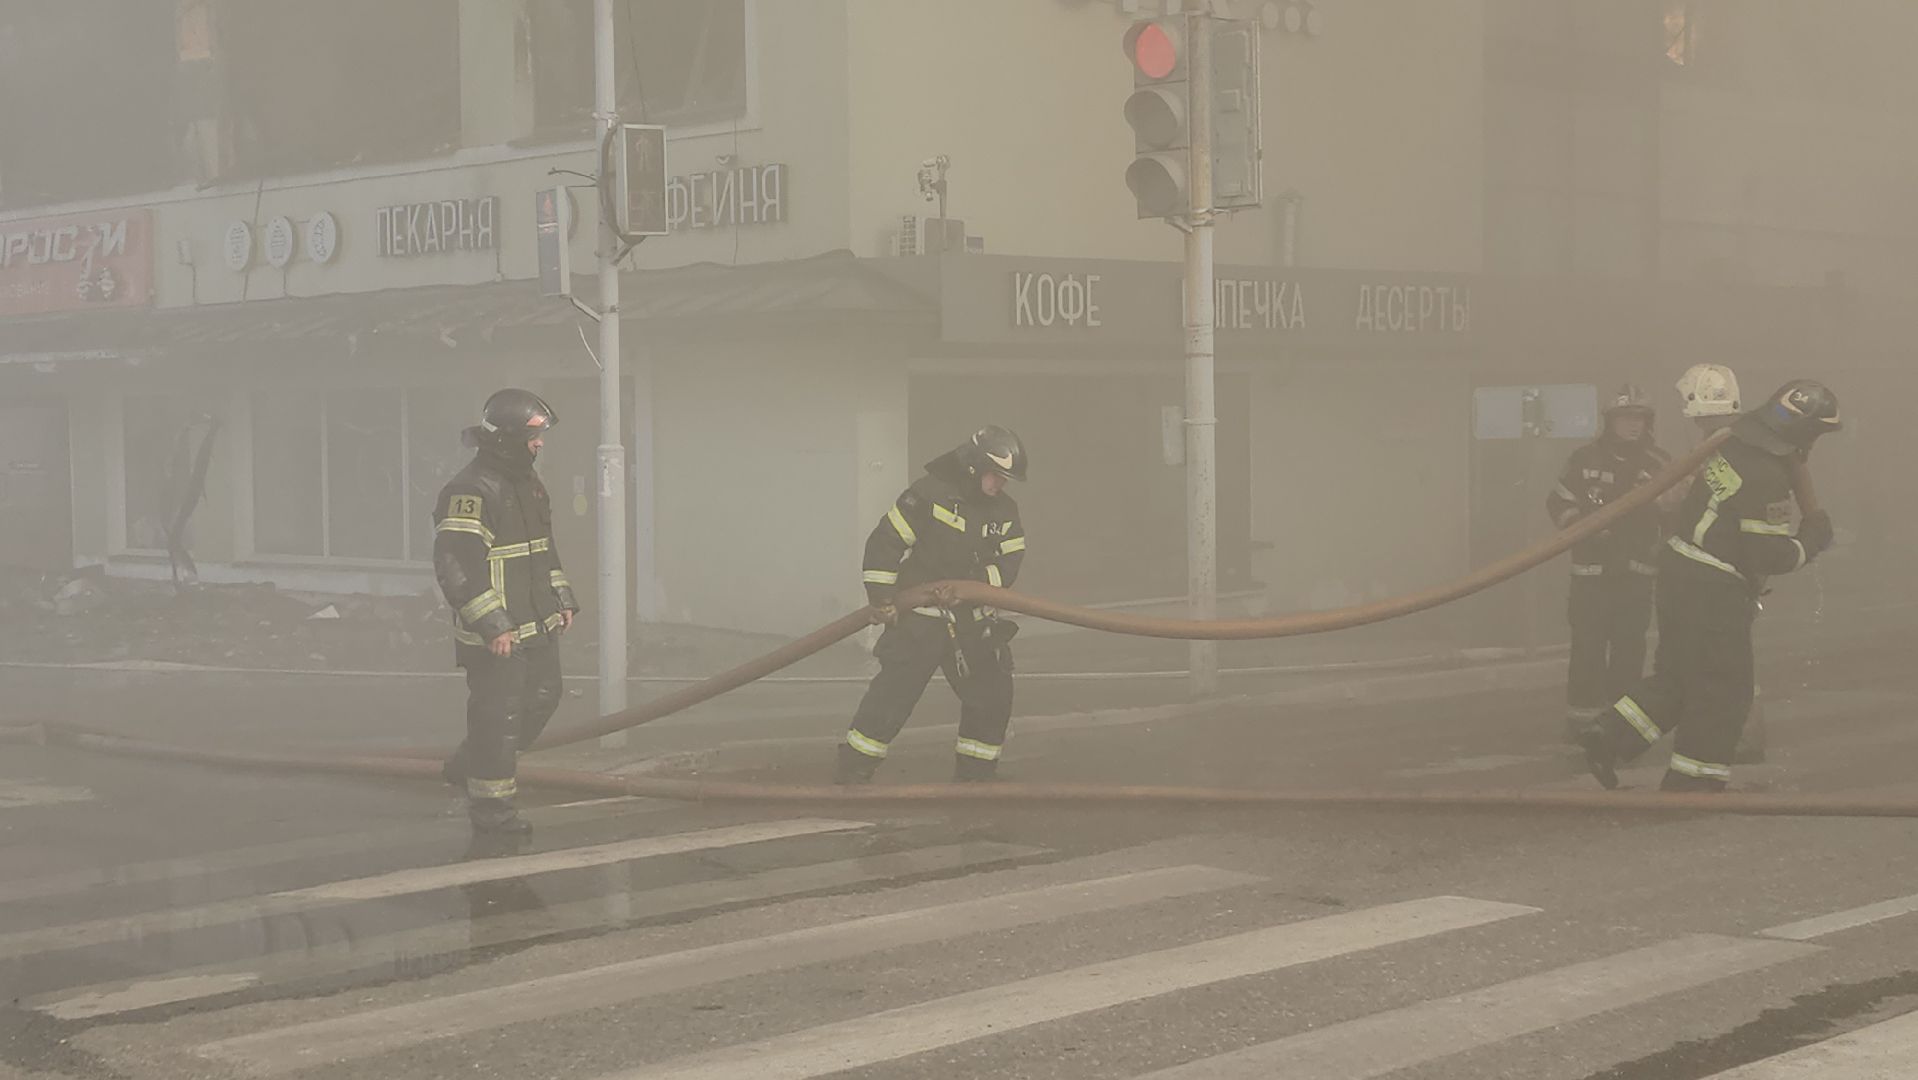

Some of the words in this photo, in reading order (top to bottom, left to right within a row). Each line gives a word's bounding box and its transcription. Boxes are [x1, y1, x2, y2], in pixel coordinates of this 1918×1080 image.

[667, 154, 782, 230] ФЕЙНЯ
[376, 197, 494, 256] ПЕКАРНЯ
[1015, 272, 1102, 327] КОФЕ
[1181, 278, 1306, 329] ПЕЧКА
[1356, 283, 1470, 332] ДЕСЕРТЫ
[456, 499, 475, 514] 13
